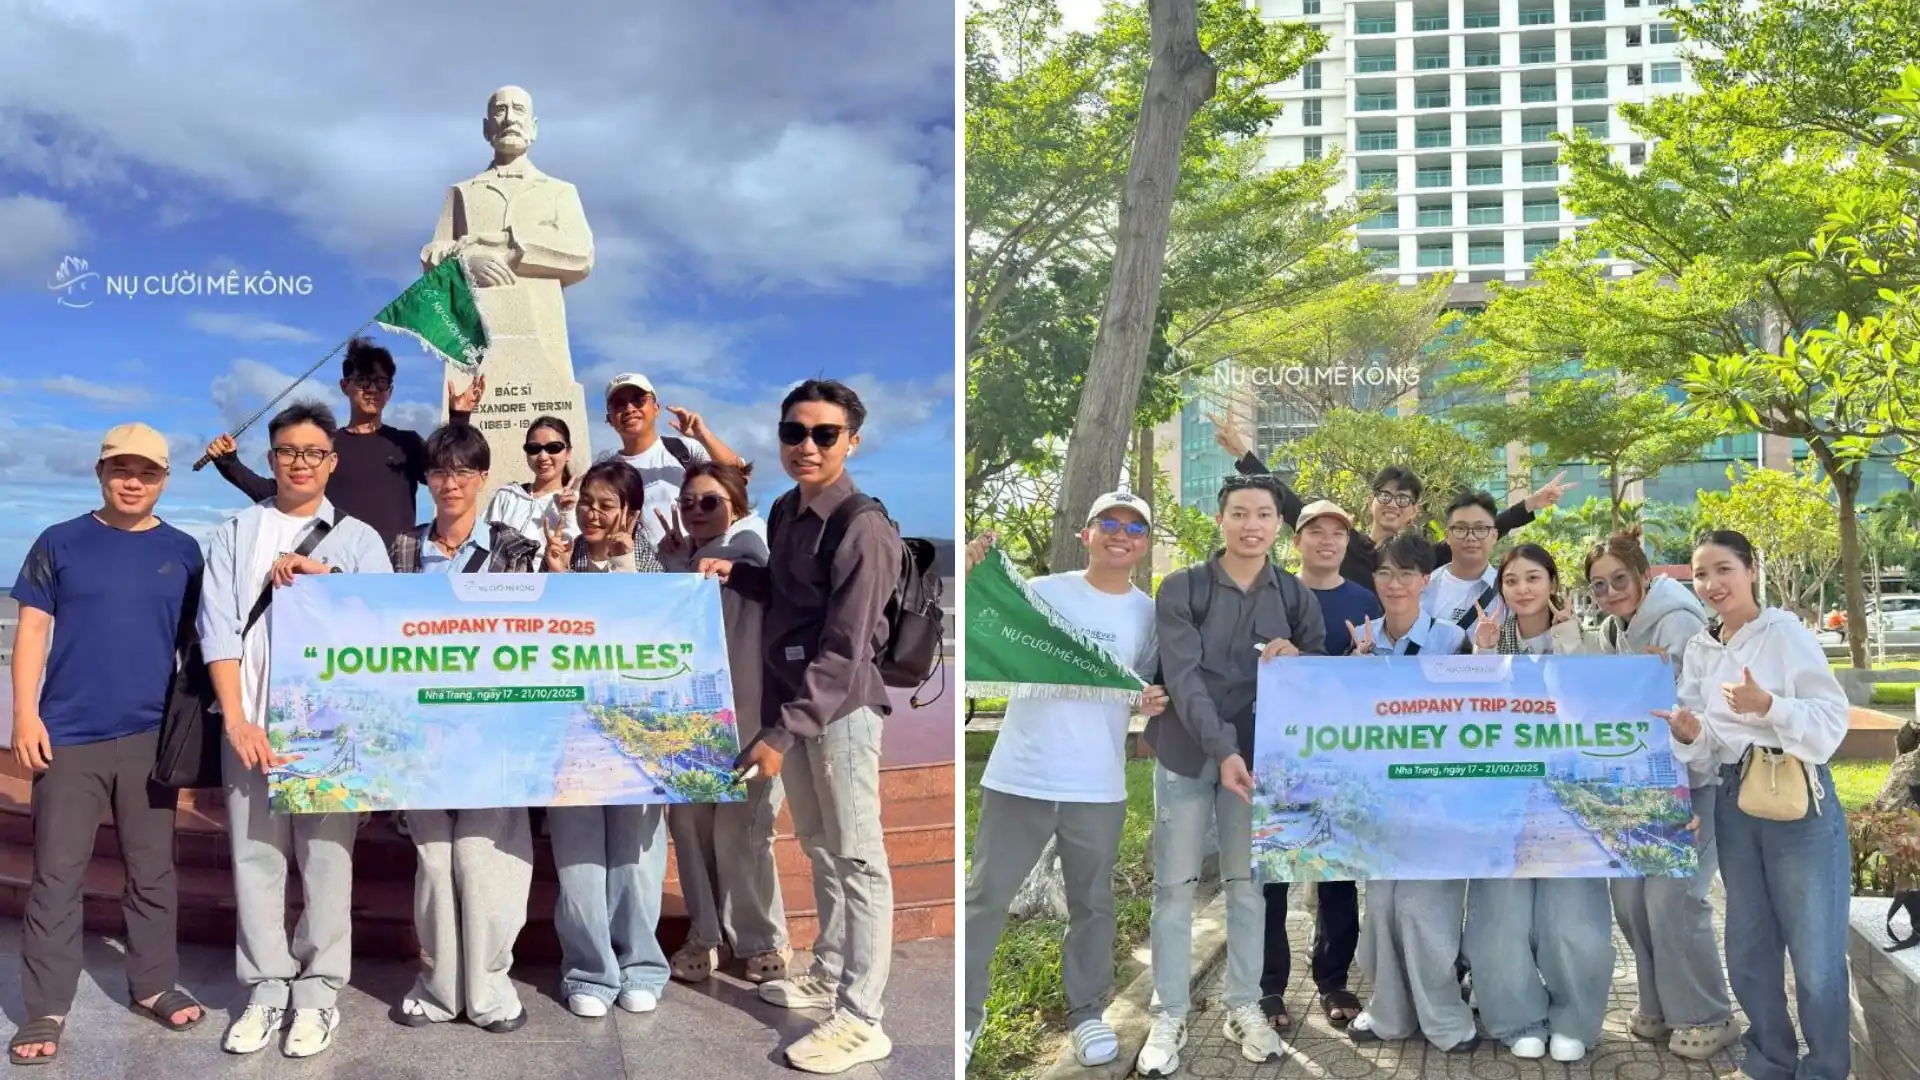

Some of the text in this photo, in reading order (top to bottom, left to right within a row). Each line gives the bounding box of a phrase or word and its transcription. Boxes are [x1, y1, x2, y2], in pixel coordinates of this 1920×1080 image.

[494, 382, 518, 397] BÁC
[472, 401, 573, 414] EXANDRE YERSIN
[402, 618, 595, 637] COMPANY TRIP 2025
[493, 644, 539, 672] OF
[551, 643, 693, 671] SMILES”
[425, 690, 444, 700] Nha
[446, 690, 475, 701] Trang,
[477, 688, 501, 701] ngày
[502, 689, 513, 699] 17
[521, 688, 578, 699] 21/10/2025
[1375, 697, 1557, 716] COMPANY TRIP 2025
[1458, 723, 1502, 749] OF
[1513, 721, 1650, 749] SMILES”
[1394, 766, 1413, 775] Nha
[1415, 765, 1442, 777] Trang,
[1468, 764, 1477, 774] 17
[1485, 763, 1539, 774] 21/10/2025
